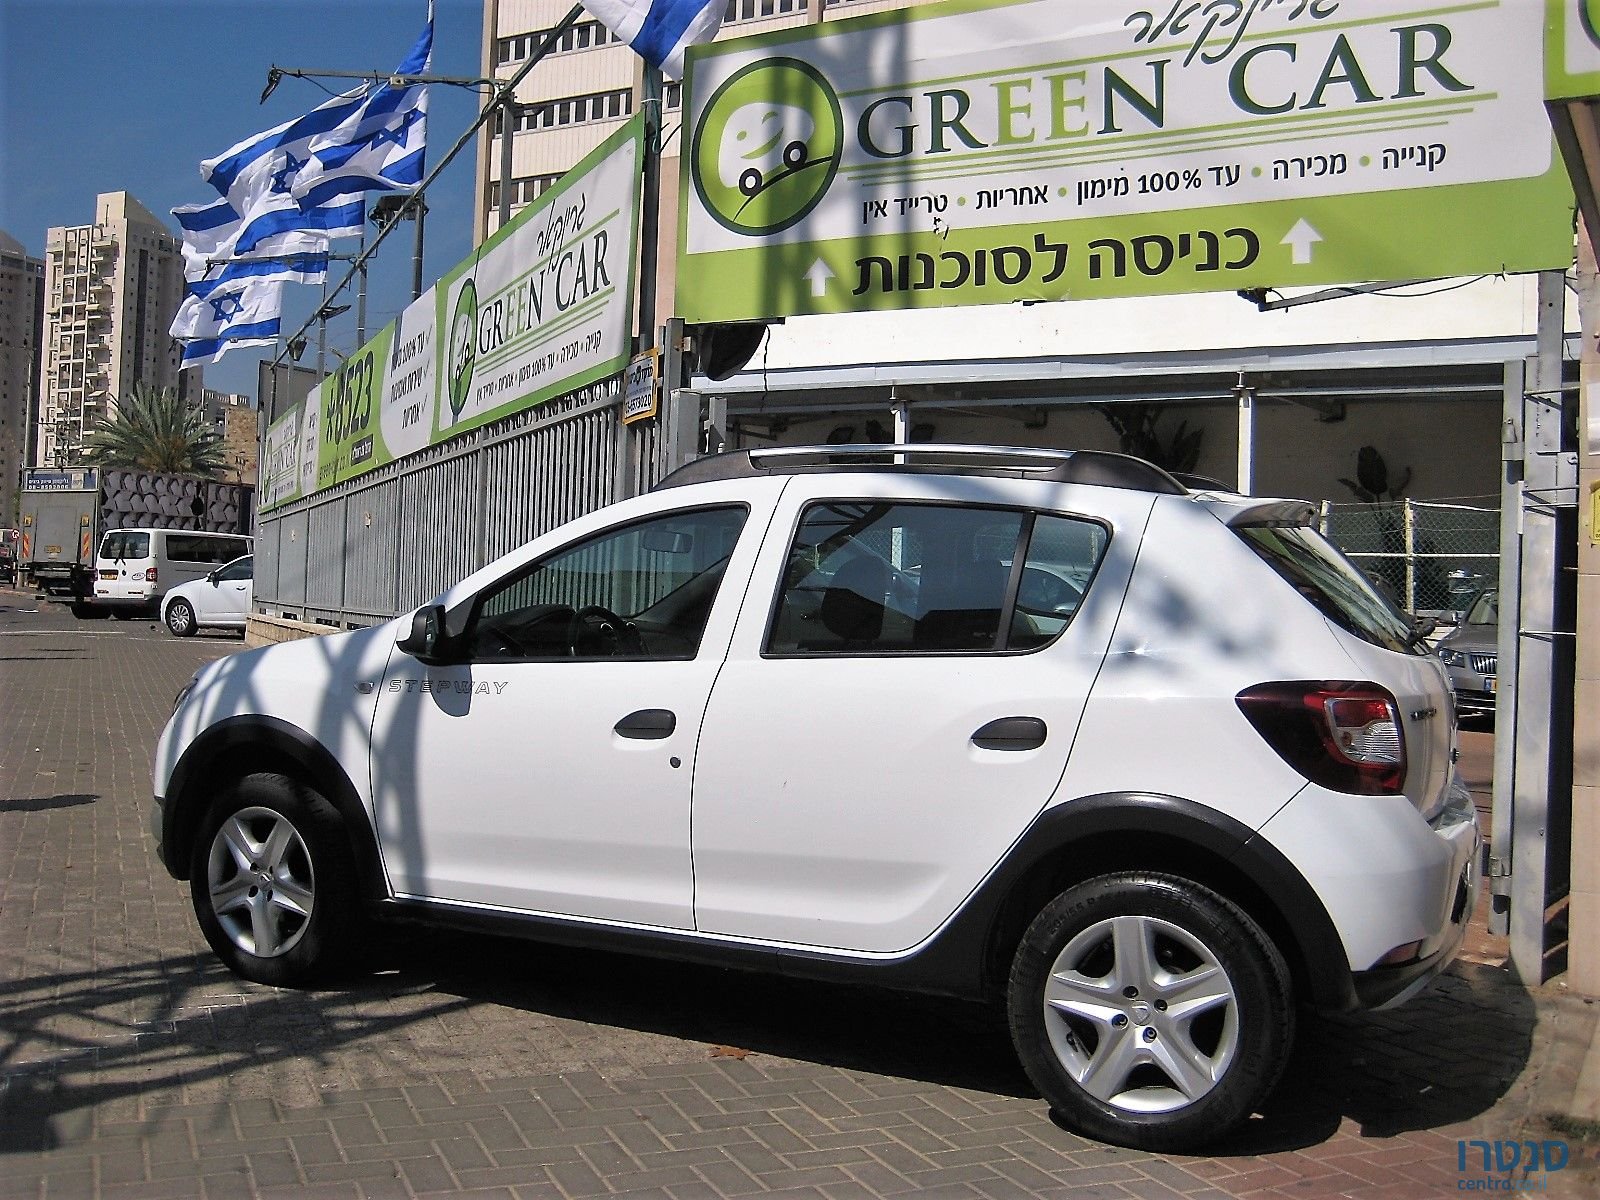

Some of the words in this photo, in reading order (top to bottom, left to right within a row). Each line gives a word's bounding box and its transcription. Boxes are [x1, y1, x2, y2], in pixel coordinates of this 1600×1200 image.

[857, 59, 1171, 159] GREEN
[1228, 22, 1475, 115] CAR
[1272, 152, 1347, 181] מכירה
[1382, 143, 1447, 172] קנייה
[1137, 170, 1202, 195] 100%
[1208, 163, 1241, 187] עד
[975, 183, 1049, 211] אחריות
[1077, 176, 1129, 205] מימון
[862, 198, 888, 225] אין
[899, 194, 949, 217] טרייד
[852, 233, 1069, 296] לסוכנות
[1088, 226, 1261, 279] כניסה
[479, 269, 545, 354] GREEN
[555, 230, 611, 311] CAR
[388, 679, 509, 695] STEPWAY
